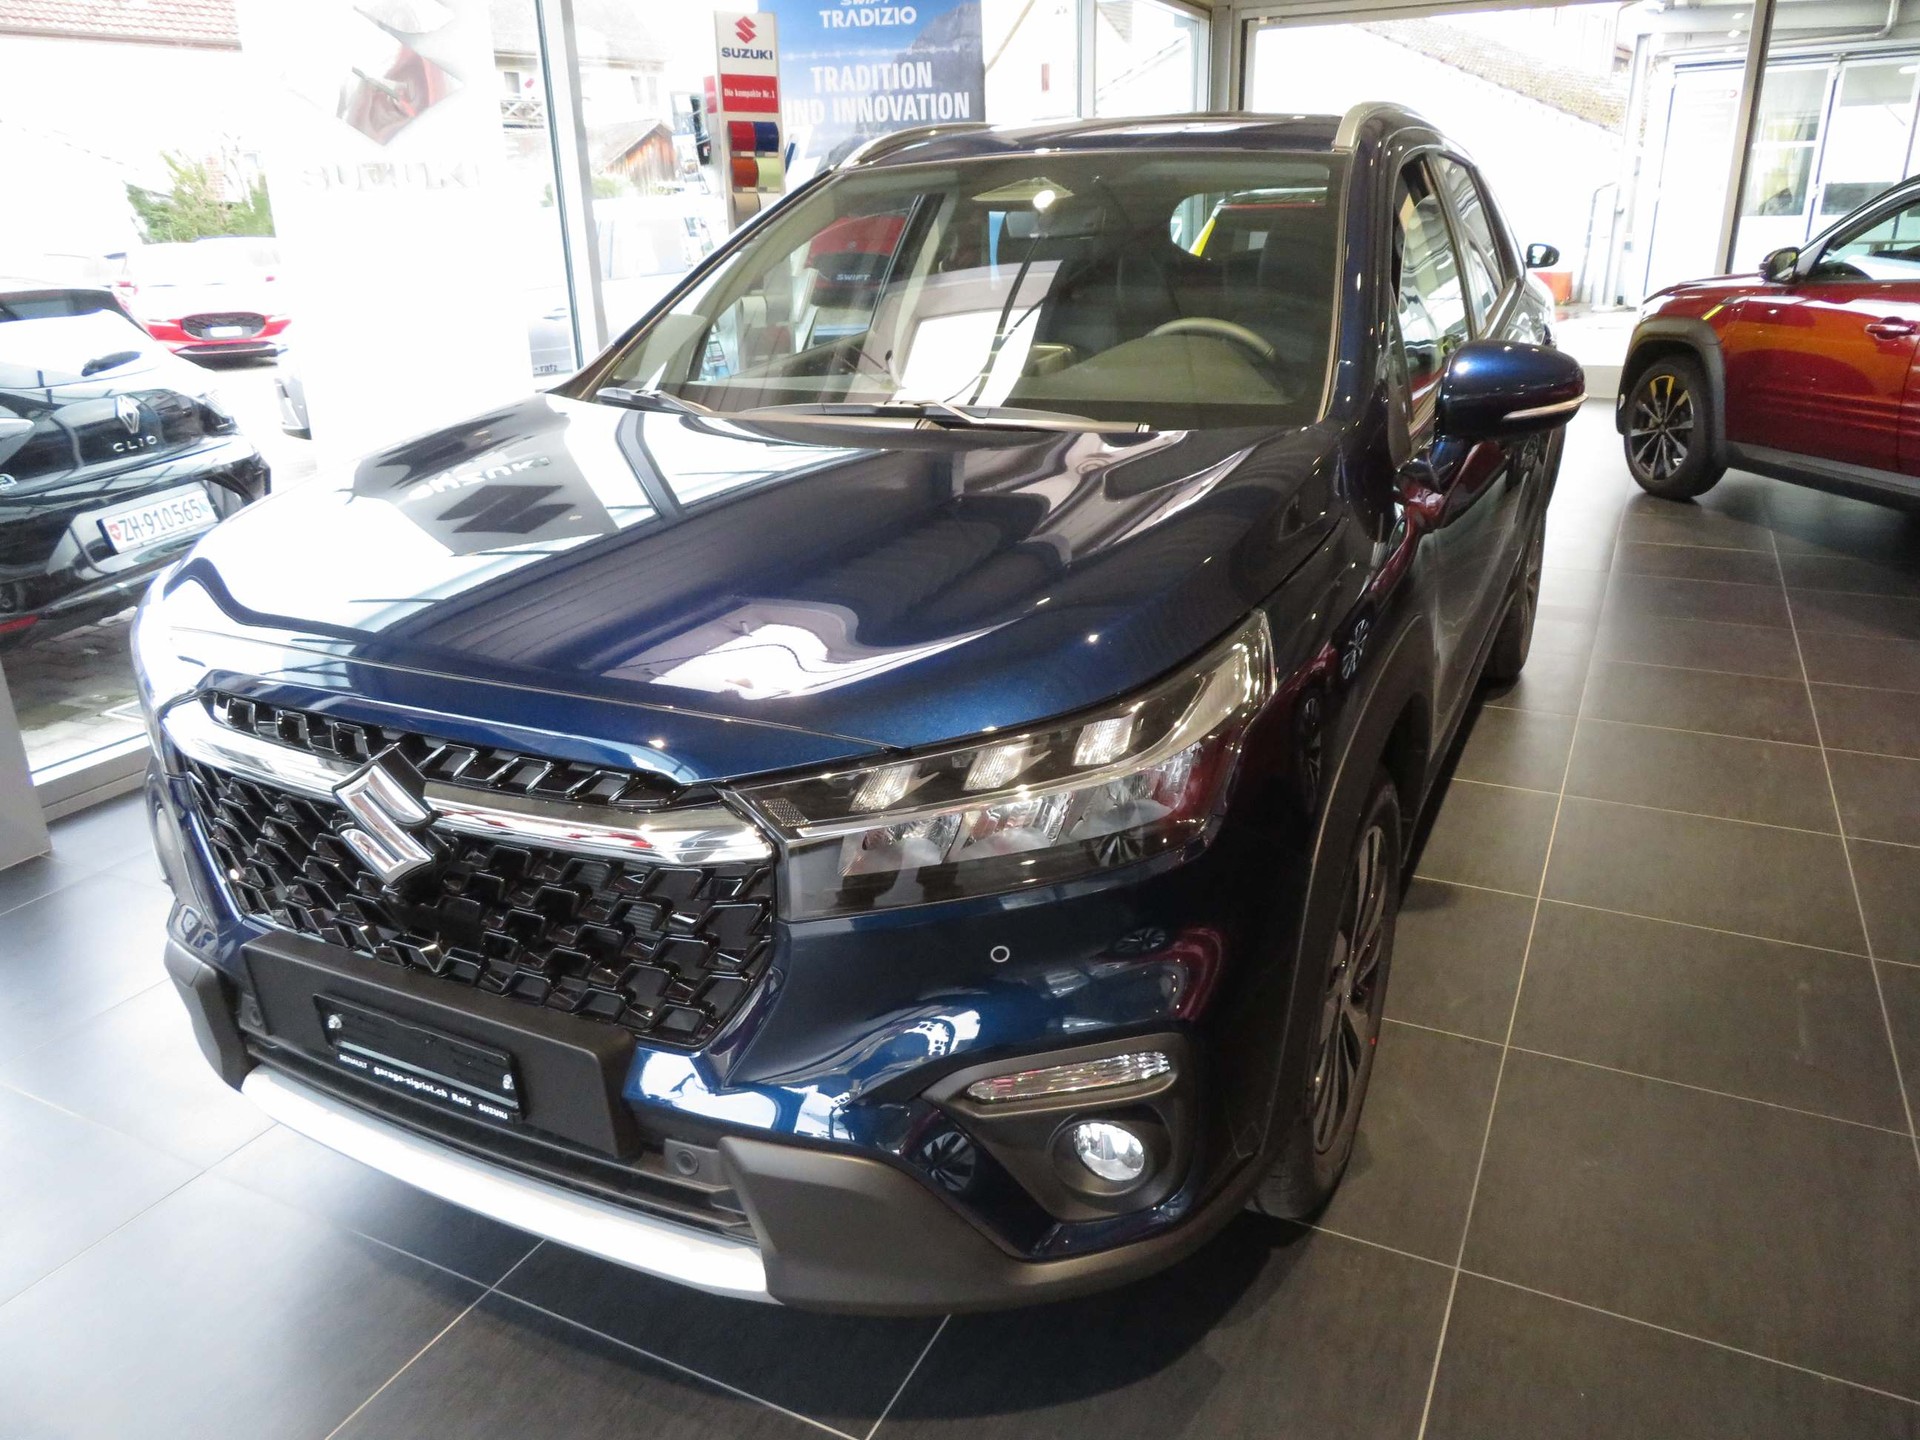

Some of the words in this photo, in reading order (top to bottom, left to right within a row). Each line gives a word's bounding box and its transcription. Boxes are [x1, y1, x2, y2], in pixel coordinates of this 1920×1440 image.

[819, 6, 917, 28] TRADIZIO
[721, 47, 774, 60] SUZUKI
[811, 61, 932, 94] TRADITION
[832, 92, 970, 123] INNOVATION
[836, 273, 871, 281] SWIFT
[113, 435, 157, 452] CLIO
[478, 1103, 508, 1120] SUZUKI
